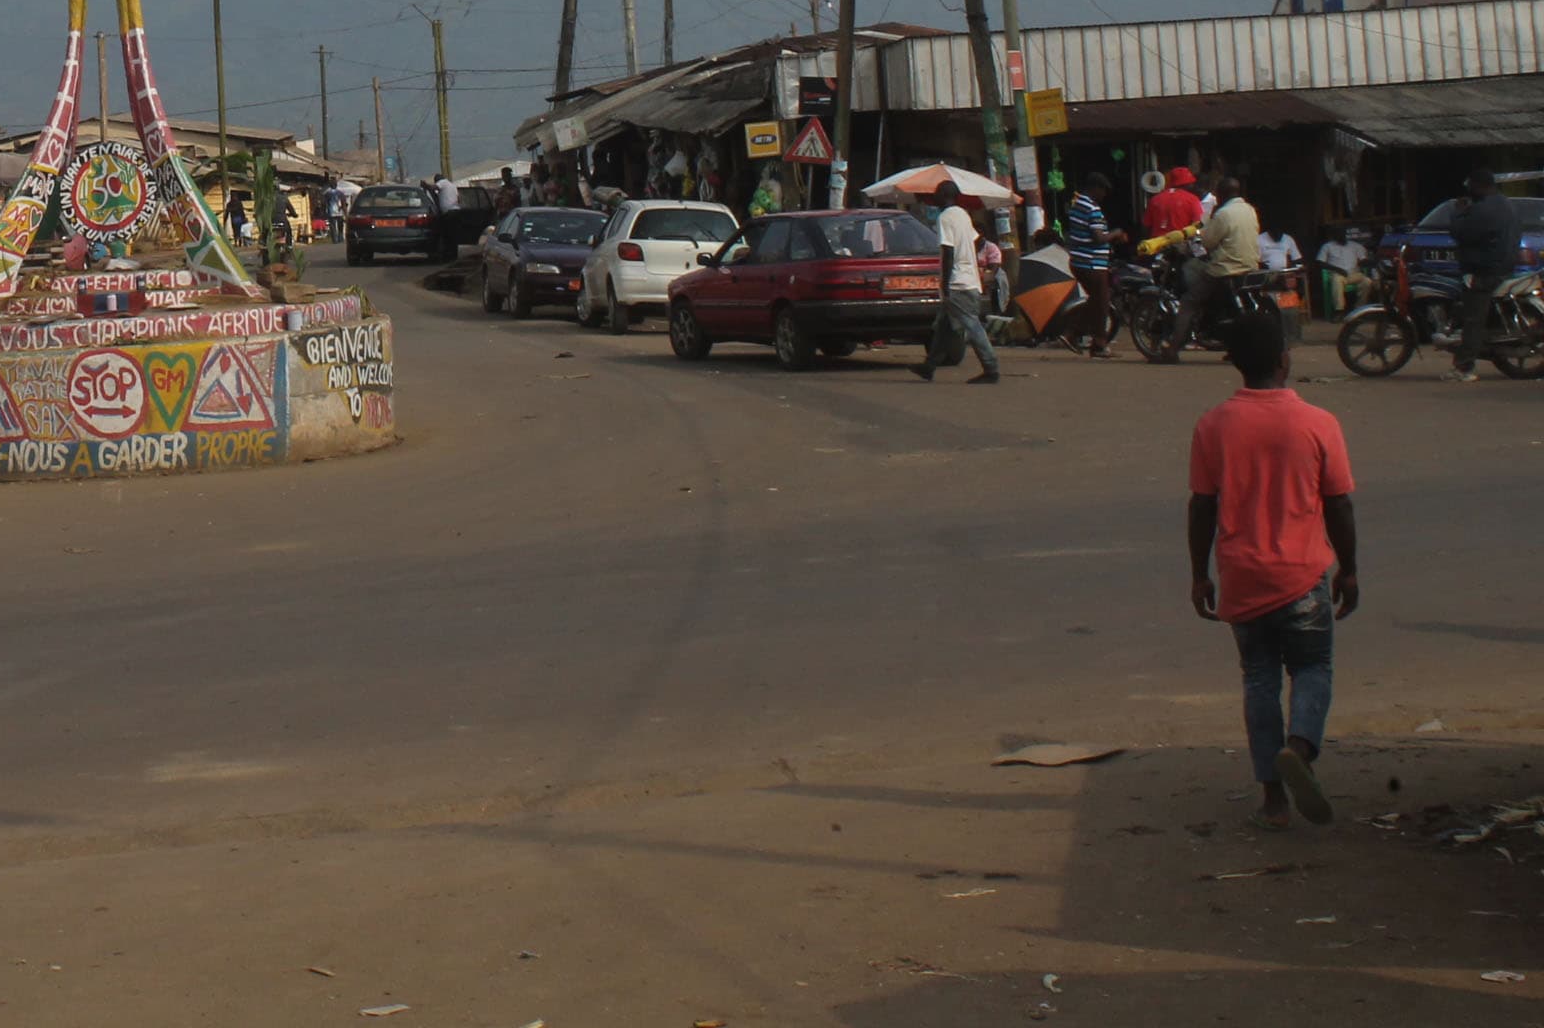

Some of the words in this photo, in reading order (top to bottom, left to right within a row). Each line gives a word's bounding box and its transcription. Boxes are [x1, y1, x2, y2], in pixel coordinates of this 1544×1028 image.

[71, 219, 139, 242] JEUNESSE
[207, 305, 285, 335] AFRIQUE
[72, 360, 137, 406] STOP
[151, 368, 185, 393] GM
[328, 365, 352, 388] AND
[345, 387, 362, 417] TO
[70, 442, 96, 477] A
[99, 432, 188, 472] GARDER
